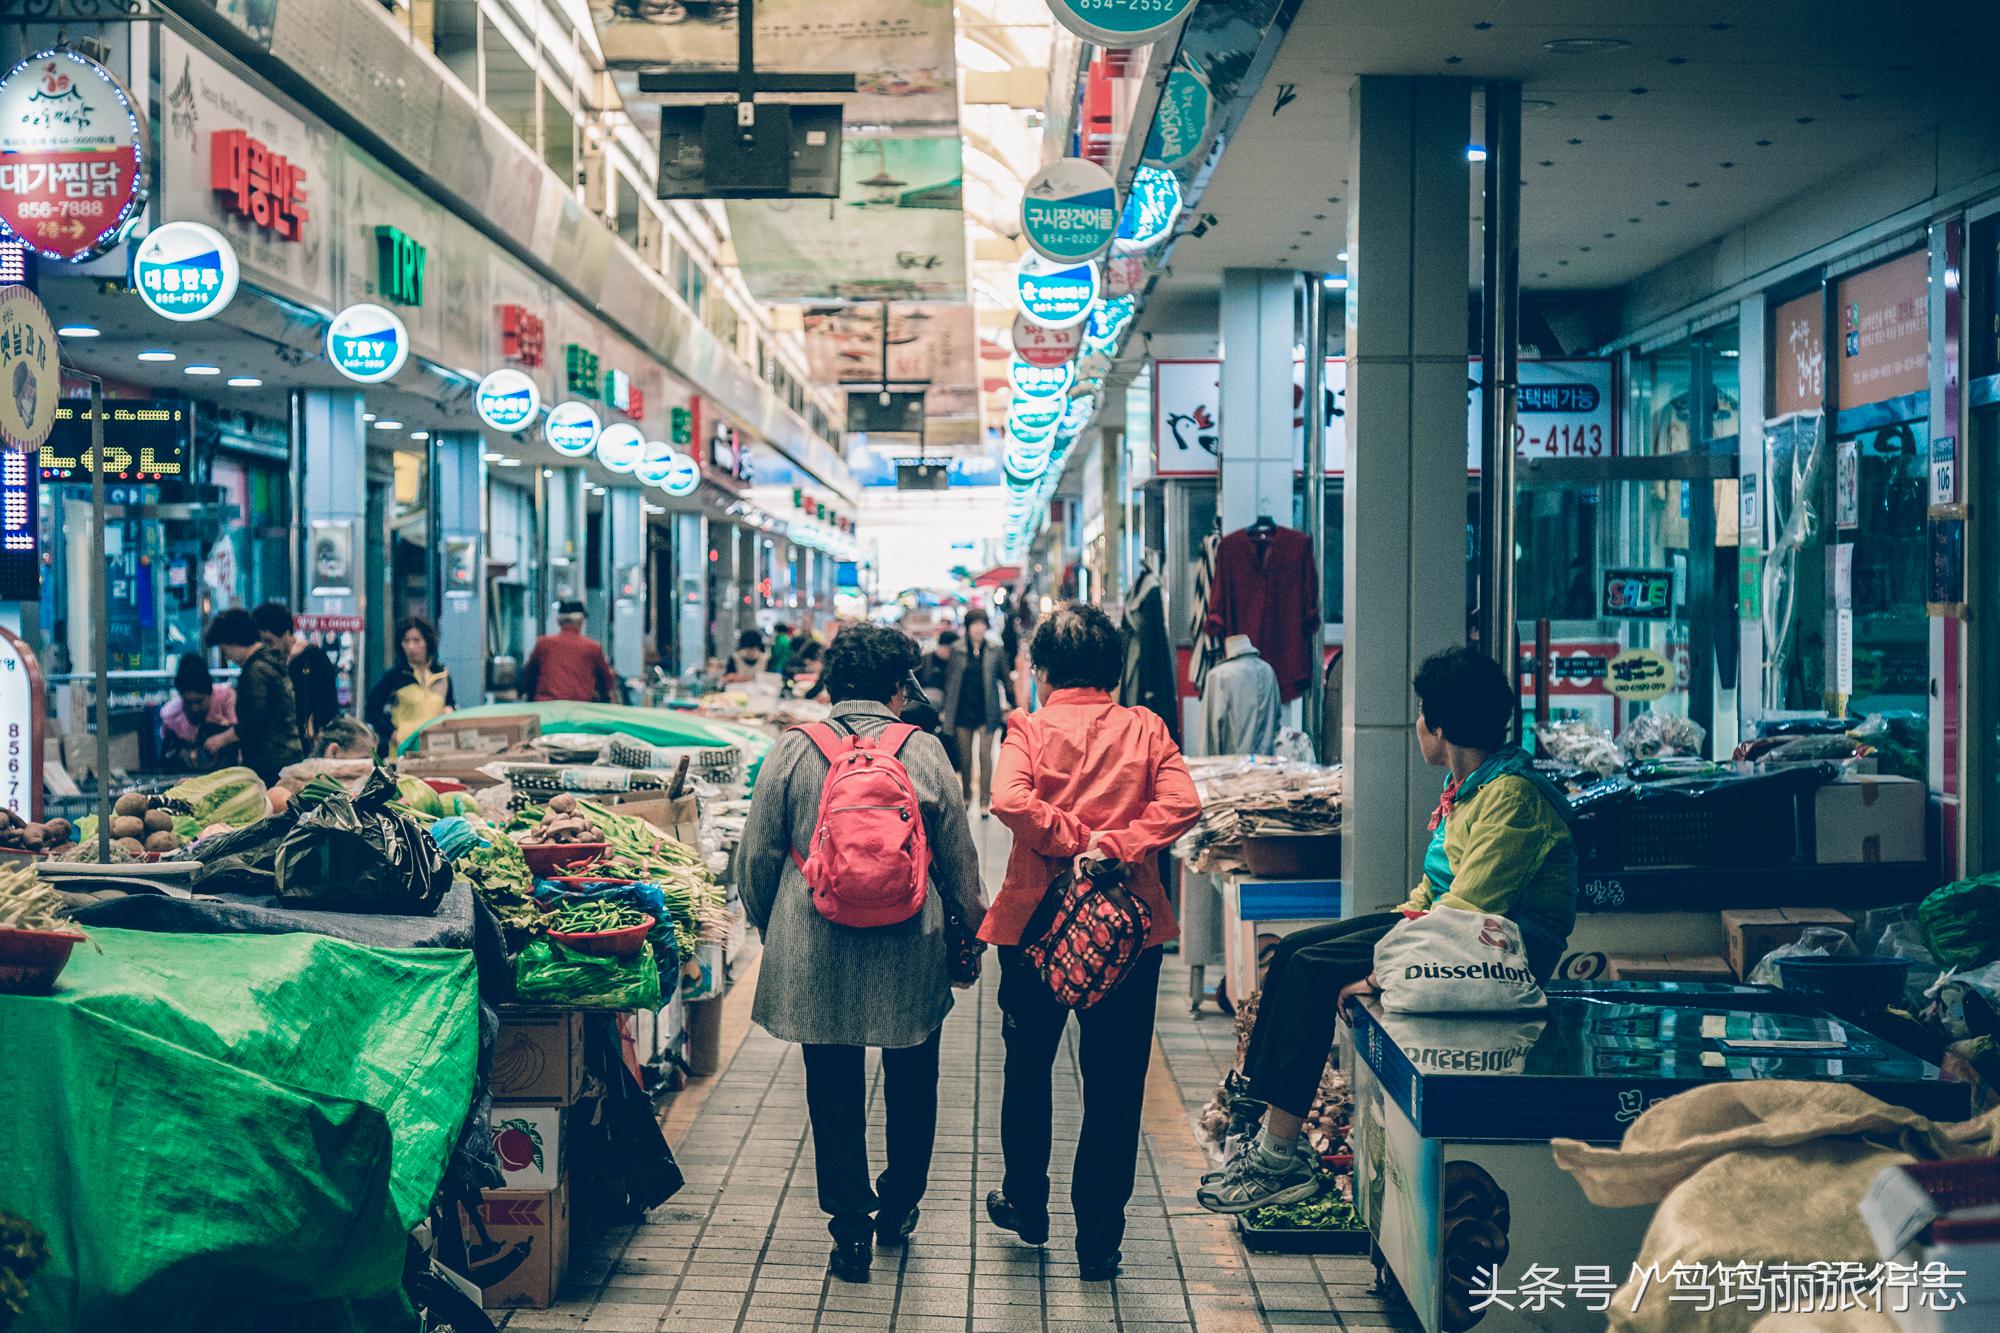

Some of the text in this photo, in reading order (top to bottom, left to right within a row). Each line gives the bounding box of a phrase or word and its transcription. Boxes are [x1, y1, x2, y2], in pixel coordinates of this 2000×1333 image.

[0, 161, 120, 198] 대가찜닭
[18, 200, 104, 219] 856-7888
[1028, 207, 1114, 230] 구시장건어물
[376, 225, 426, 306] TRY
[343, 340, 386, 358] TRY
[1936, 467, 1950, 491] 106
[1607, 578, 1669, 610] SALE
